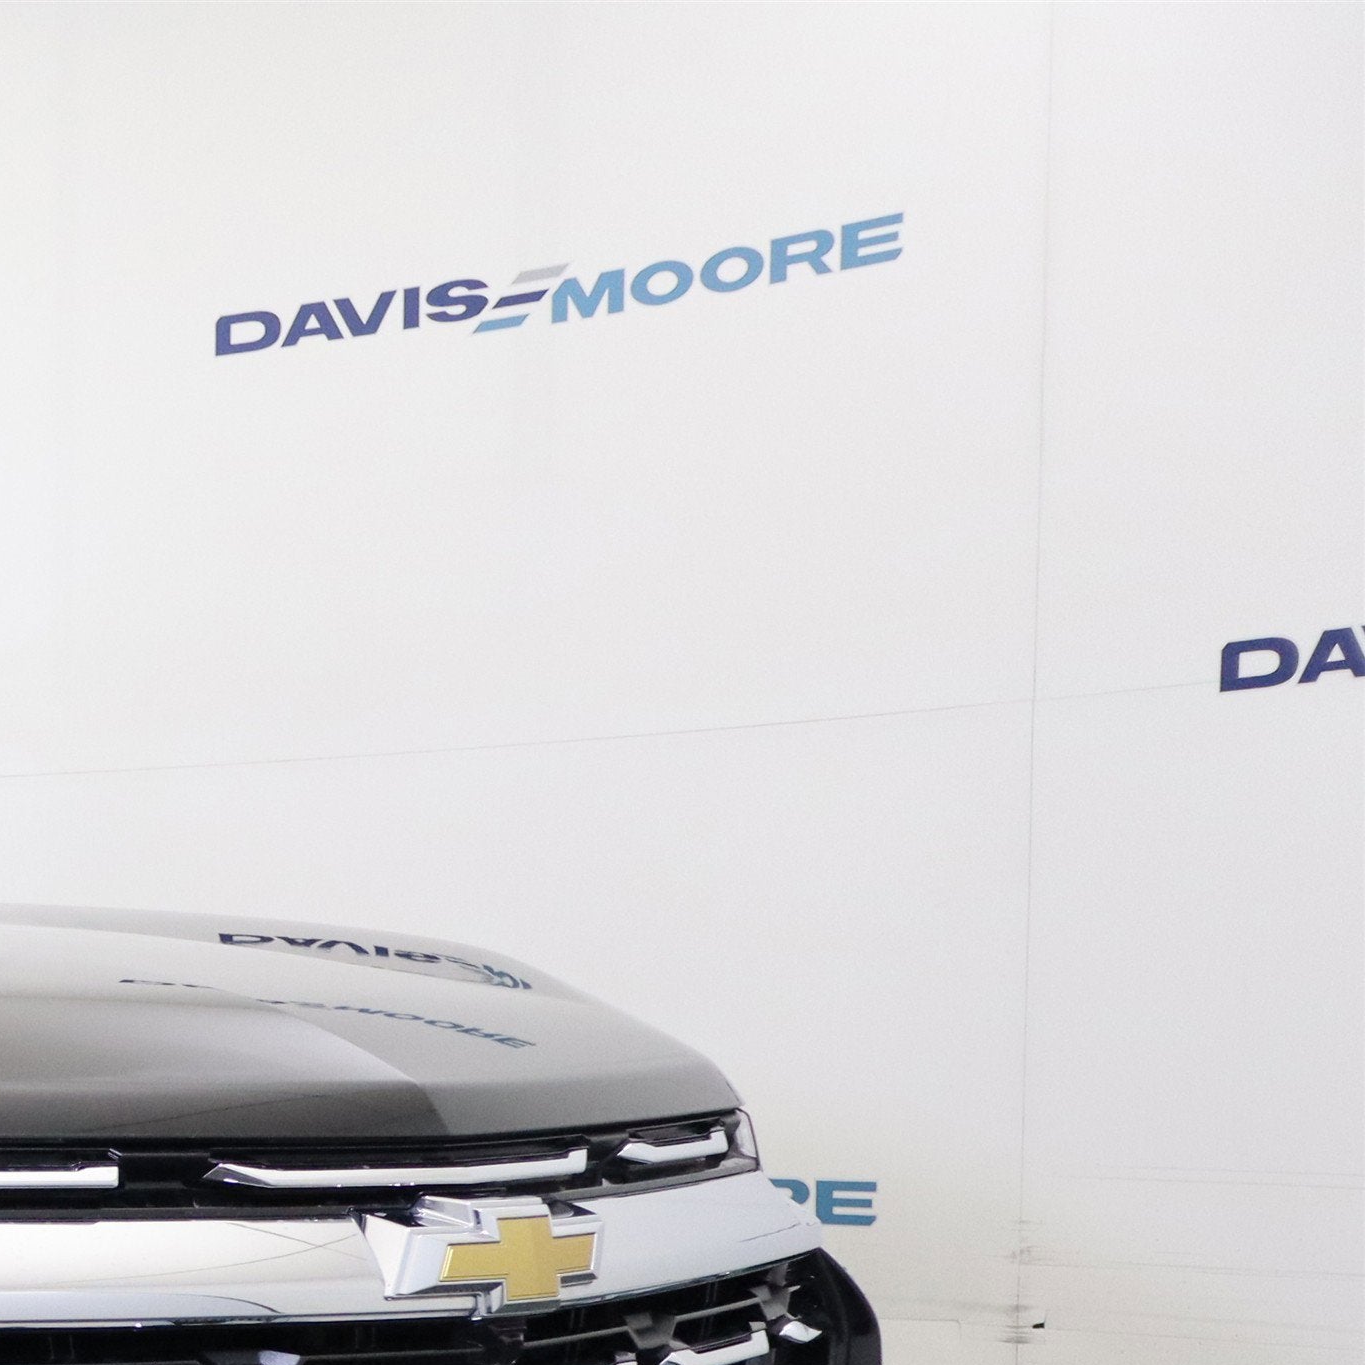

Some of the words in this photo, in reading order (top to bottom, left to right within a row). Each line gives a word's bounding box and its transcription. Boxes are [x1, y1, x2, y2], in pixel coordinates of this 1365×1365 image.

[215, 277, 490, 357] DAVIS
[550, 212, 904, 324] MOORE
[1219, 624, 1365, 692] DA
